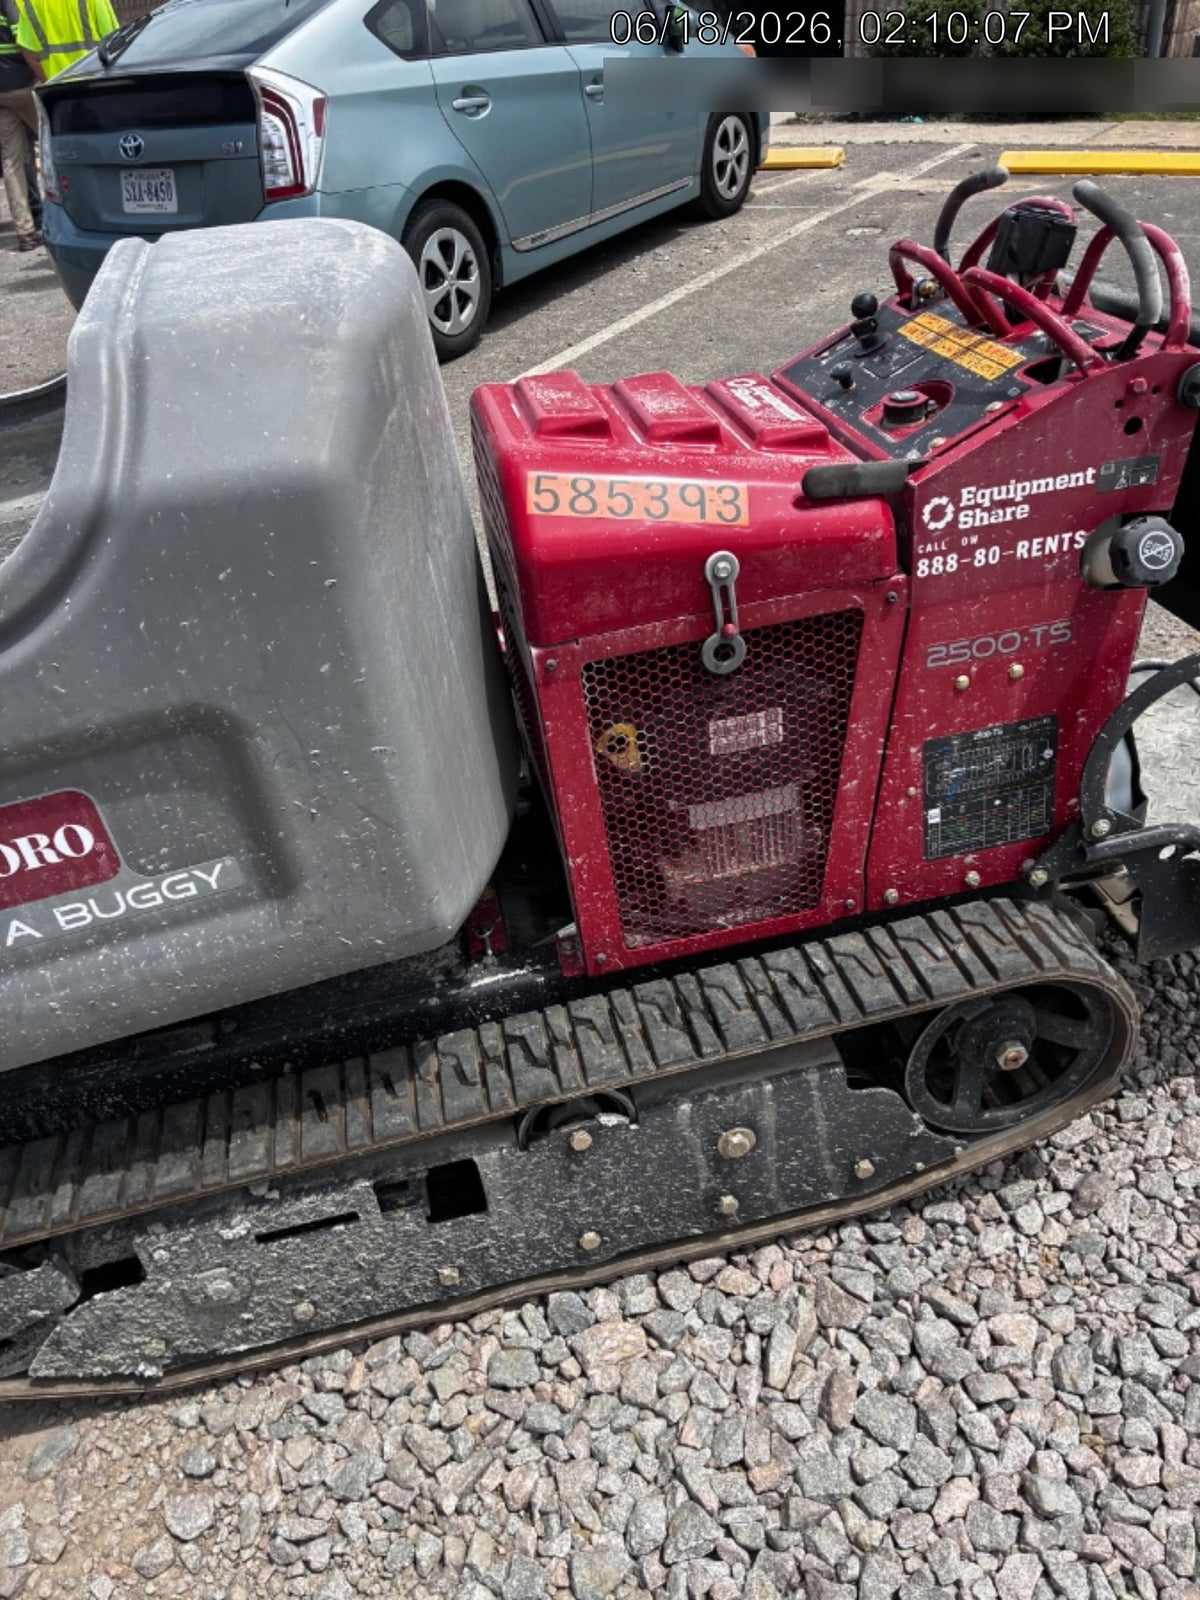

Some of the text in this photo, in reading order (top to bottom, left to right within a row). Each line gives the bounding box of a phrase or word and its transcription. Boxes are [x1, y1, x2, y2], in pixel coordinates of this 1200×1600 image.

[533, 474, 742, 524] 585393
[959, 467, 1097, 507] Equipment
[958, 503, 1030, 529] Share
[916, 529, 1088, 578] 888-80-RENTS
[917, 541, 947, 554] CALL
[53, 863, 223, 930] BUGGY
